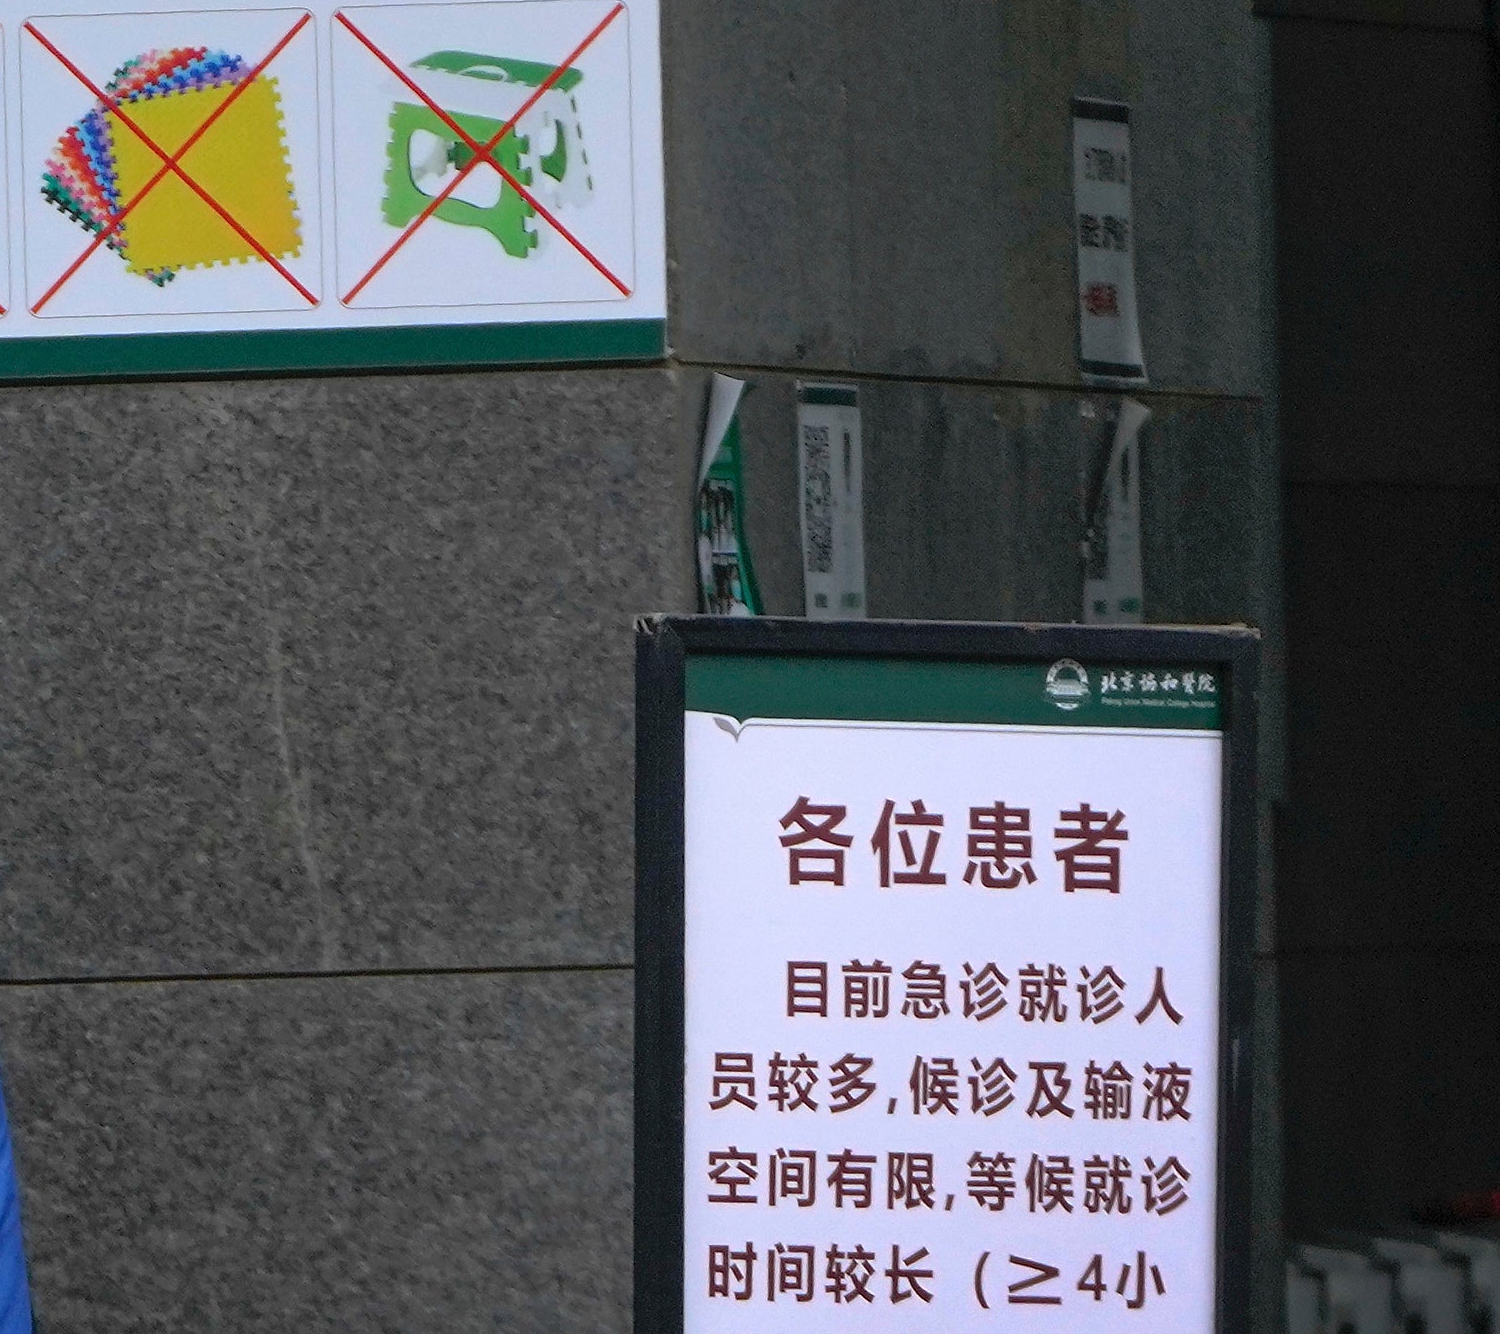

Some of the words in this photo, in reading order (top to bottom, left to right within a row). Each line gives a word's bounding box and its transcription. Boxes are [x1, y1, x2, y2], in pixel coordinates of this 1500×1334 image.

[778, 796, 1130, 895] 各位患者
[786, 958, 1184, 1027] 目前急诊就诊人
